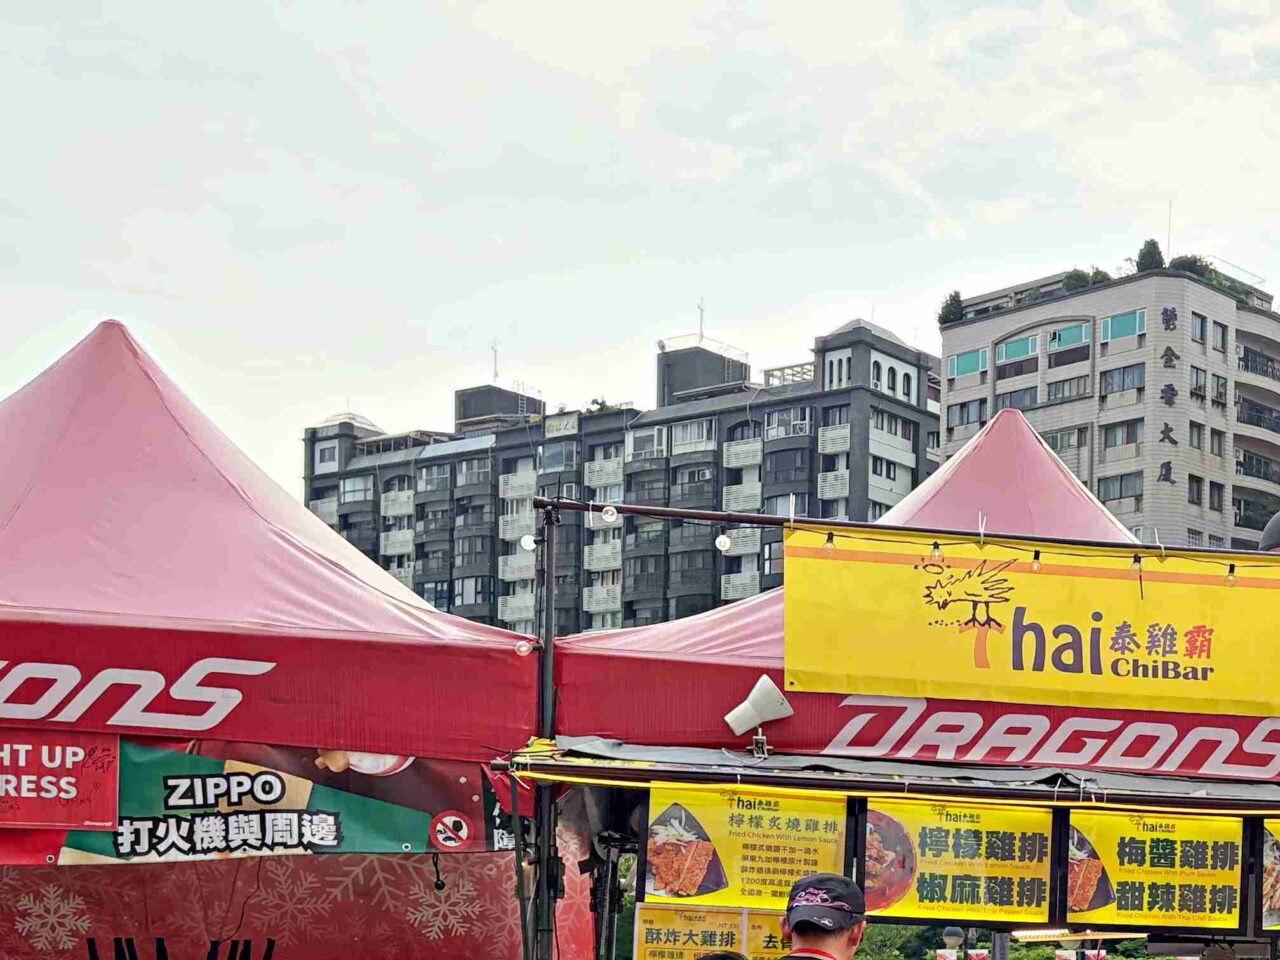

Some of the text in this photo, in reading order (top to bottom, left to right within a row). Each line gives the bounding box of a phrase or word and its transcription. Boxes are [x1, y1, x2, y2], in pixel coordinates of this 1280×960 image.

[959, 607, 1103, 675] Thai
[1109, 620, 1213, 660] 泰雞霸
[1110, 657, 1215, 682] ChiBar
[0, 657, 277, 731] ONS
[41, 745, 85, 769] UP
[167, 771, 283, 808] ZIPPO
[118, 813, 340, 854] 打火機與周邊
[729, 813, 839, 834] 檸檬炙燒雞排
[747, 832, 775, 840] Chicken
[919, 827, 1048, 863] 檸檬雞排
[1117, 837, 1239, 870] 梅醬雞排
[917, 872, 1047, 907] 椒麻雞排
[1116, 881, 1237, 914] 甜辣雞排
[645, 927, 736, 948] 酥炸大雞排
